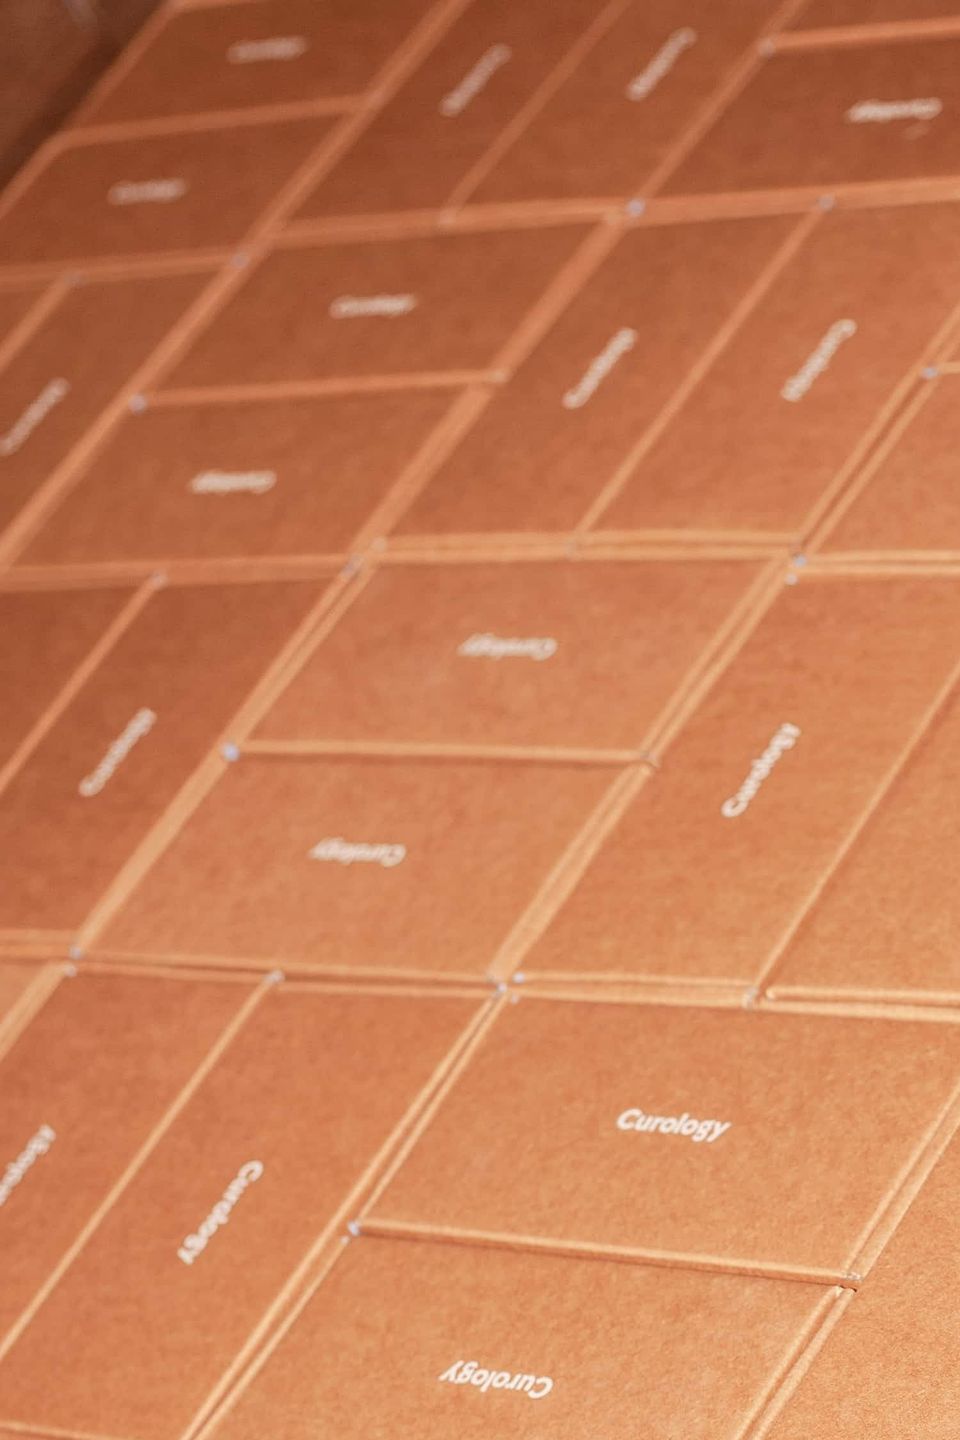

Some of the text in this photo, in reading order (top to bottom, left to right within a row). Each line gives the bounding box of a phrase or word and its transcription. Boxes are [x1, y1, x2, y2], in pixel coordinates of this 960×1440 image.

[721, 723, 801, 818] Curology
[616, 1108, 731, 1143] Curology
[177, 1160, 264, 1265] Curology
[438, 1360, 554, 1399] Curology
